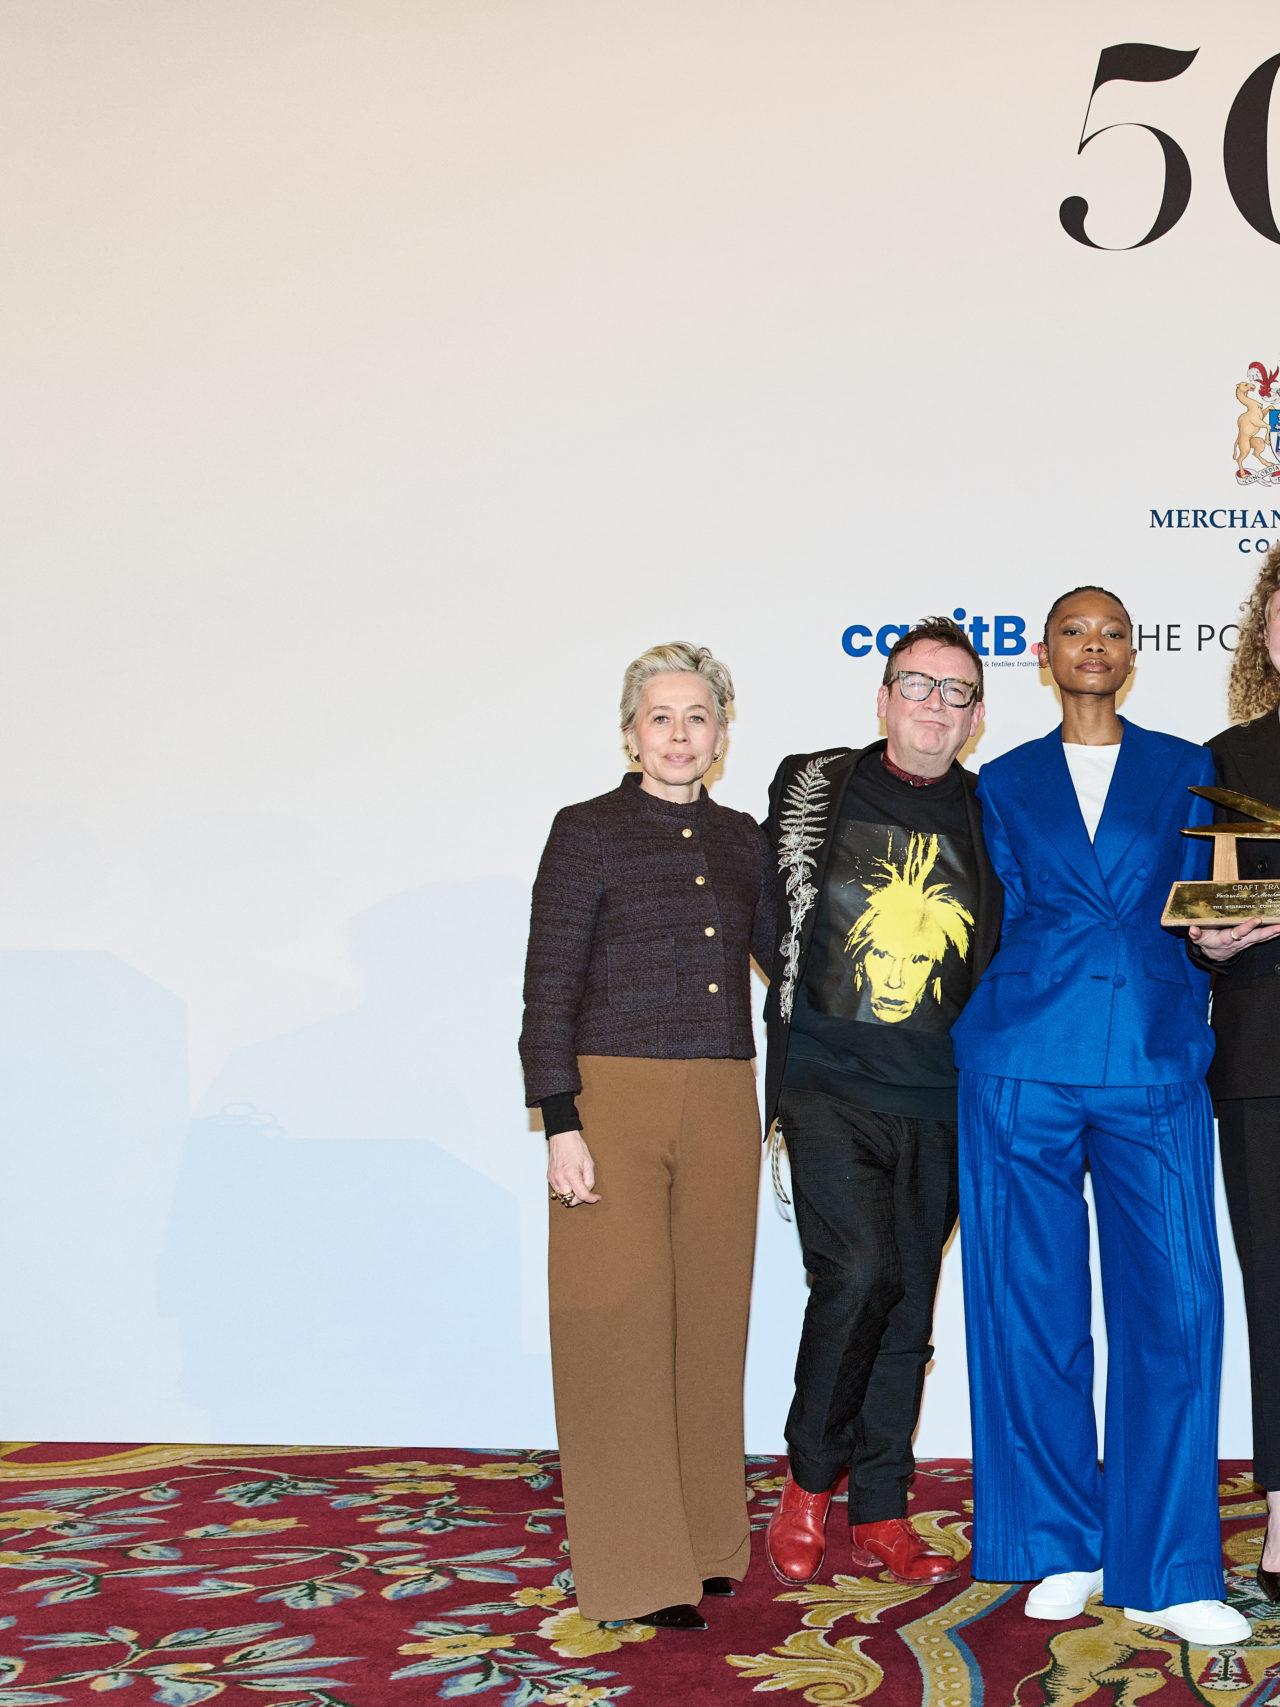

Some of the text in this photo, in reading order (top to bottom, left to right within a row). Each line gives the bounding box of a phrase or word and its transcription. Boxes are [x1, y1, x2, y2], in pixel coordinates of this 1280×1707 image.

[1137, 623, 1182, 652] HE
[991, 660, 1015, 668] textiles
[1016, 660, 1040, 668] trainin
